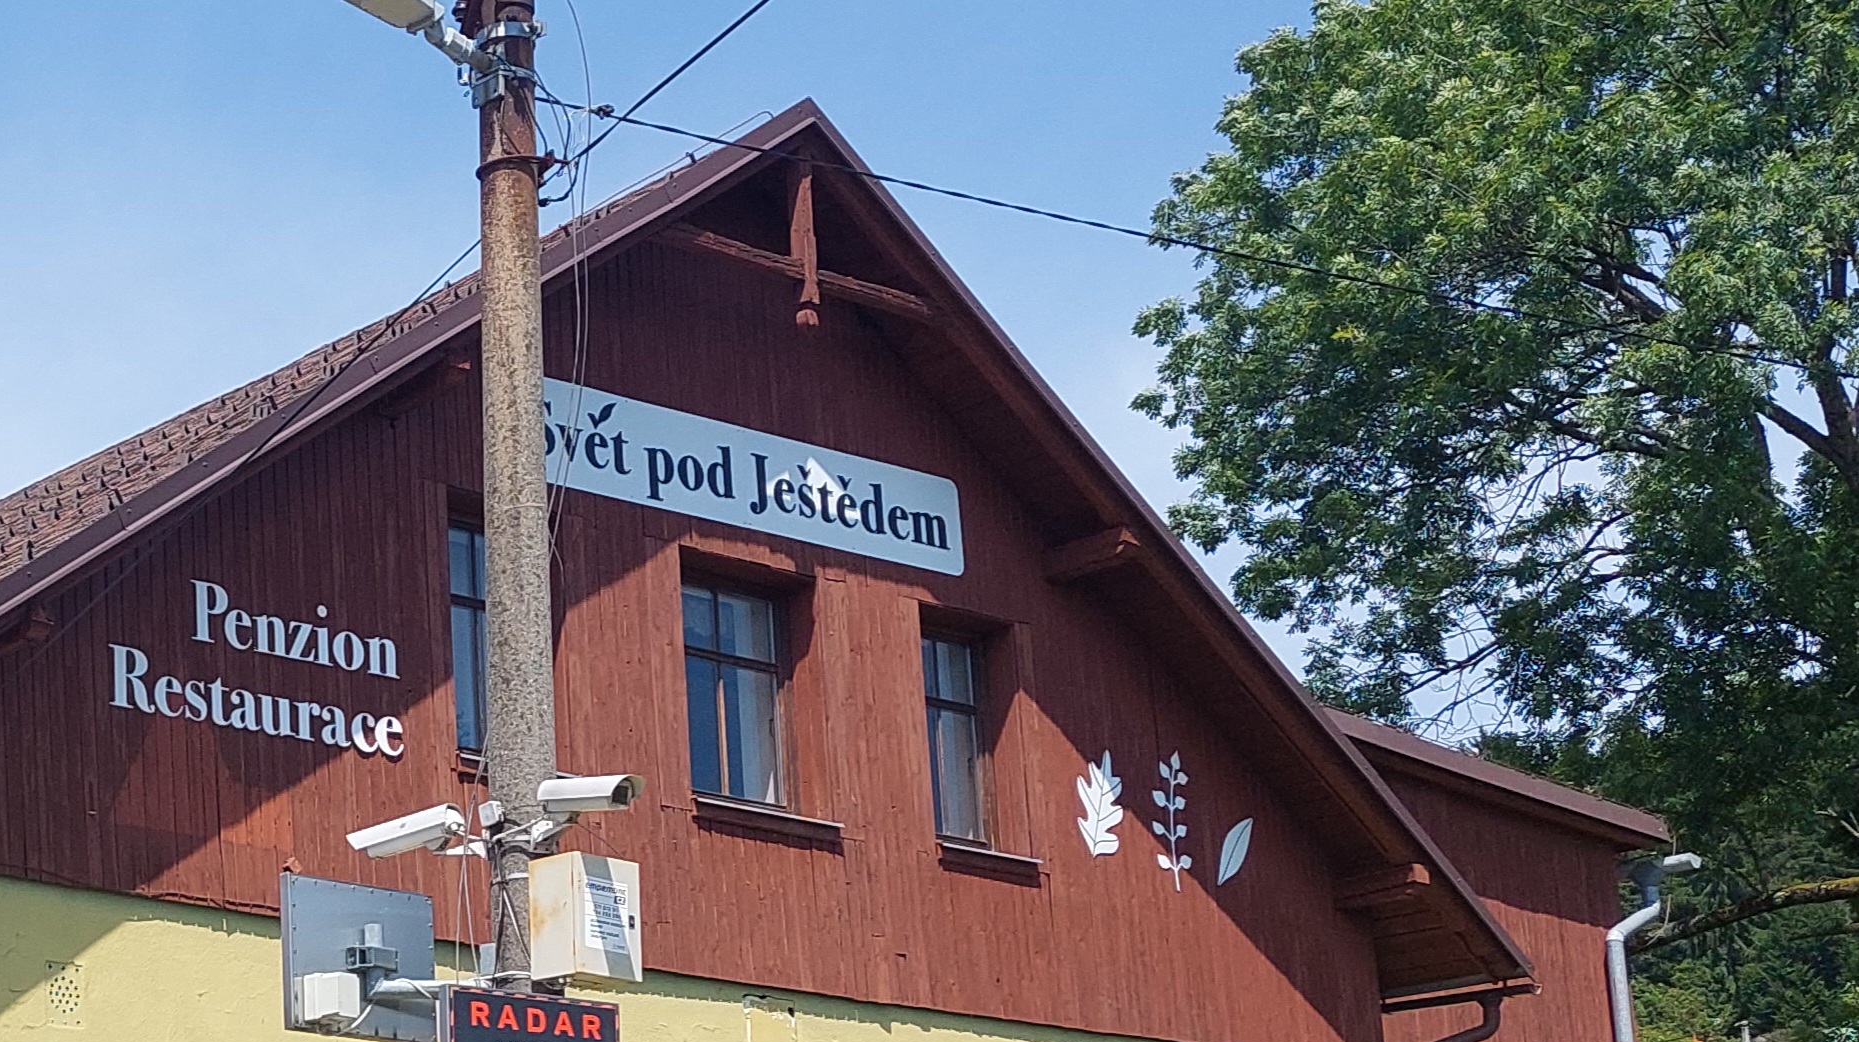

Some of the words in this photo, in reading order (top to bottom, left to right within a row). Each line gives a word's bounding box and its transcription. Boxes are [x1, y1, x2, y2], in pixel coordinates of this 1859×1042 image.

[643, 445, 737, 501] pod
[749, 452, 951, 551] Ještědem
[190, 579, 400, 679] Penzion
[108, 643, 404, 757] Restaurace
[470, 1001, 602, 1040] RADAR
